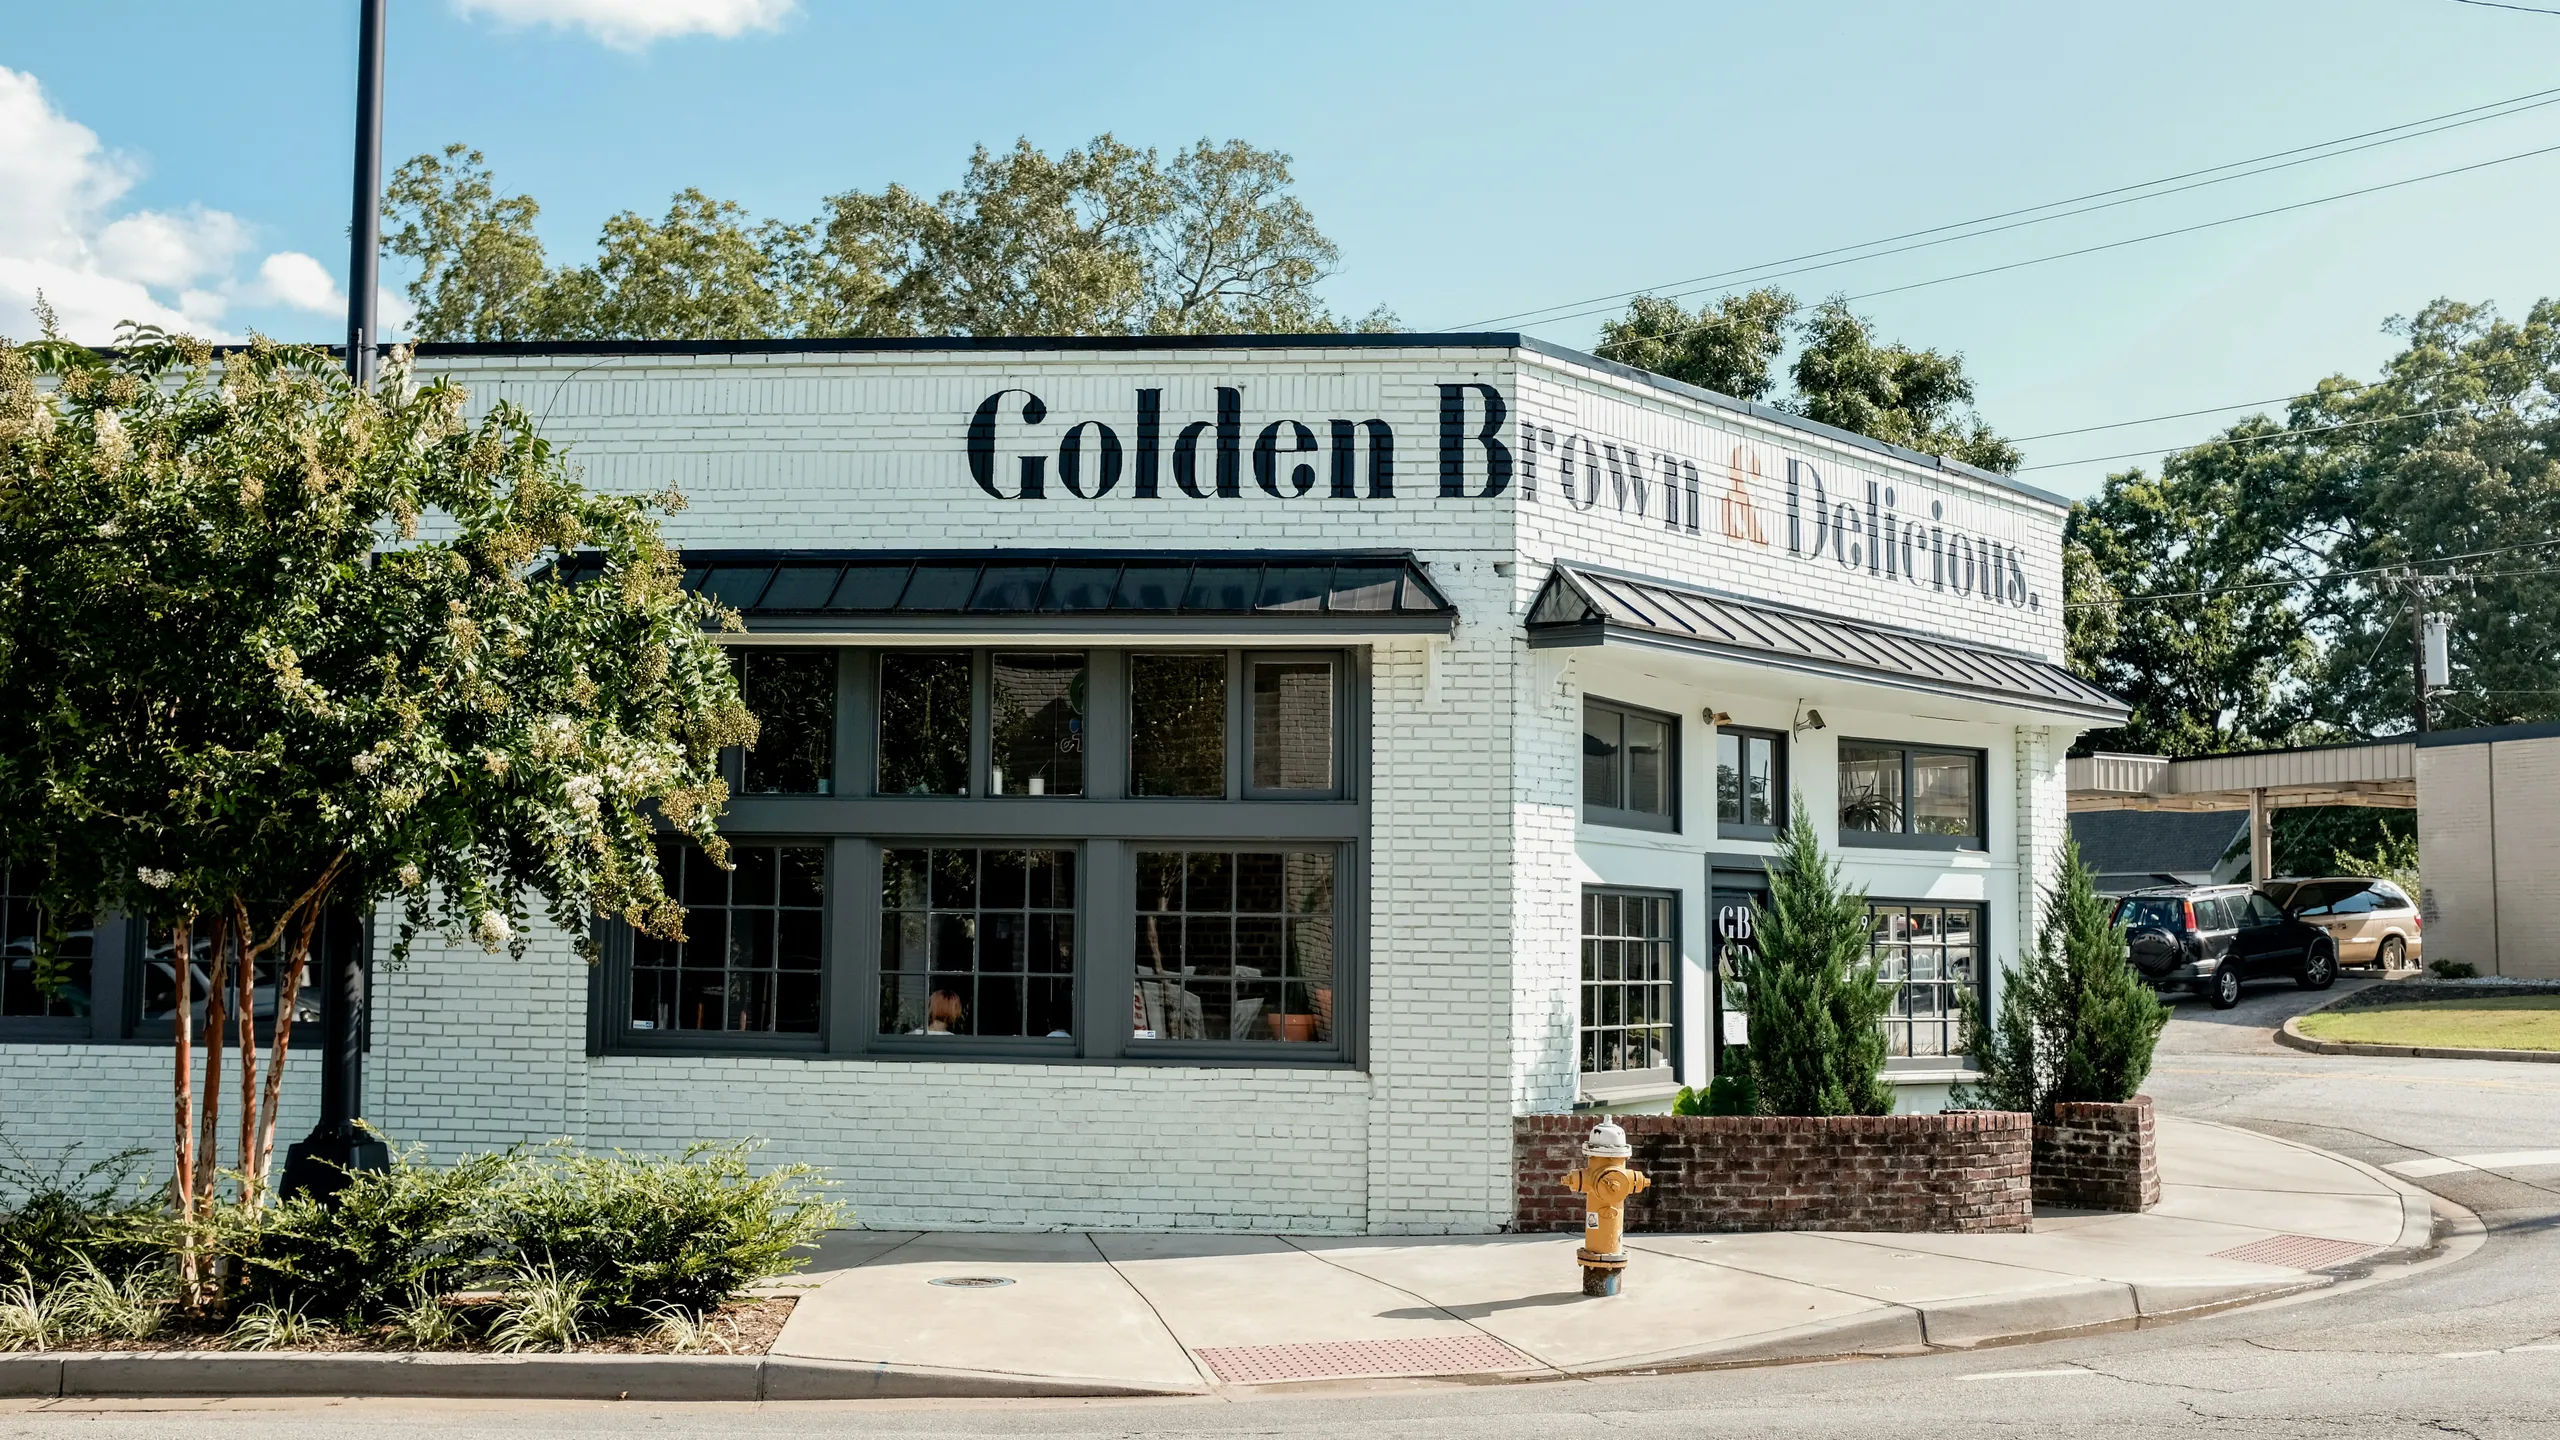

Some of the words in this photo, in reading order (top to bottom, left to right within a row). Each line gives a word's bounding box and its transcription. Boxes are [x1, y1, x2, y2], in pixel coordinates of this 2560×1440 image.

[966, 386, 1397, 500] Golden
[1434, 383, 1701, 537] Brown
[1721, 444, 1768, 549] &
[1786, 457, 2039, 612] Delicious.
[1719, 905, 1751, 939] GB
